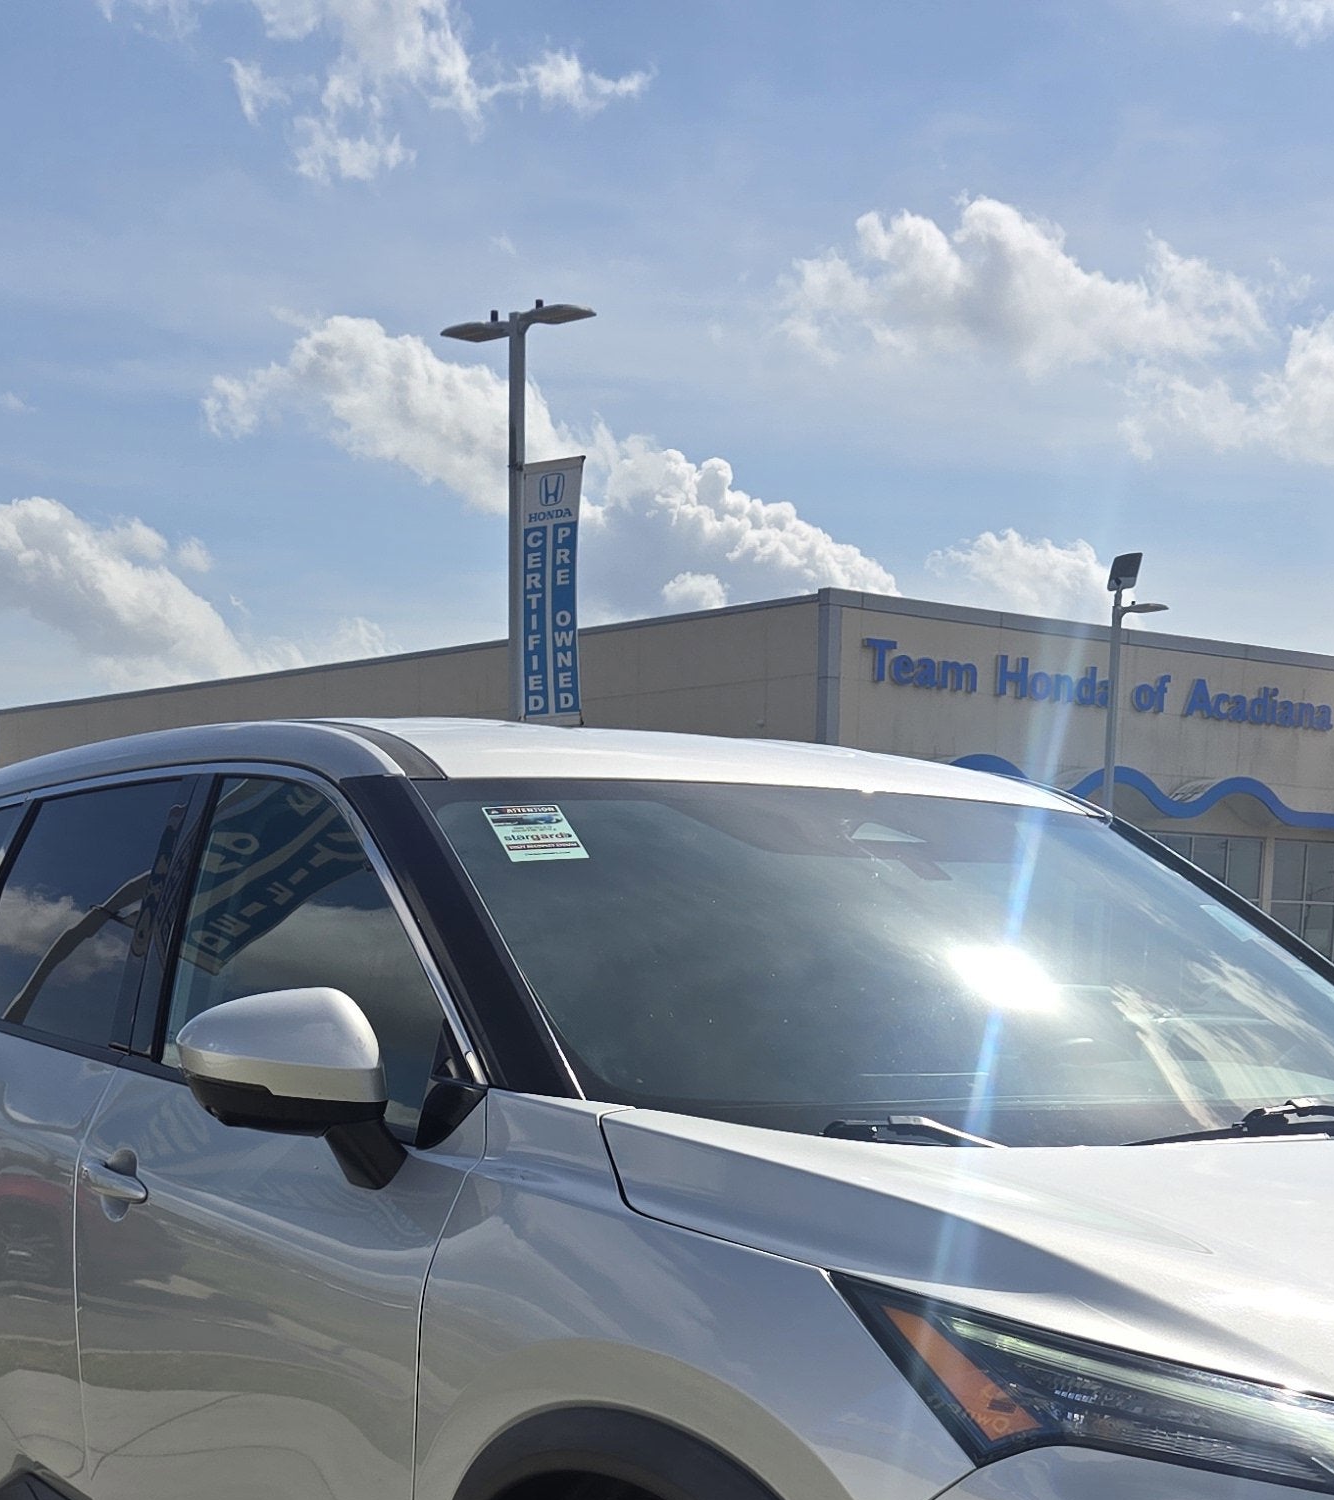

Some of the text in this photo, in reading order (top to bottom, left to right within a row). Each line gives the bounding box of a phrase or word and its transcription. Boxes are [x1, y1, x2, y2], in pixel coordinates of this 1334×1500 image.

[528, 508, 572, 522] HONDA
[526, 530, 545, 712] CERTIFIED
[553, 526, 574, 709] PRE OWNED
[862, 637, 1334, 732] Team Honda of Acadiana
[506, 806, 556, 814] ATTENTION
